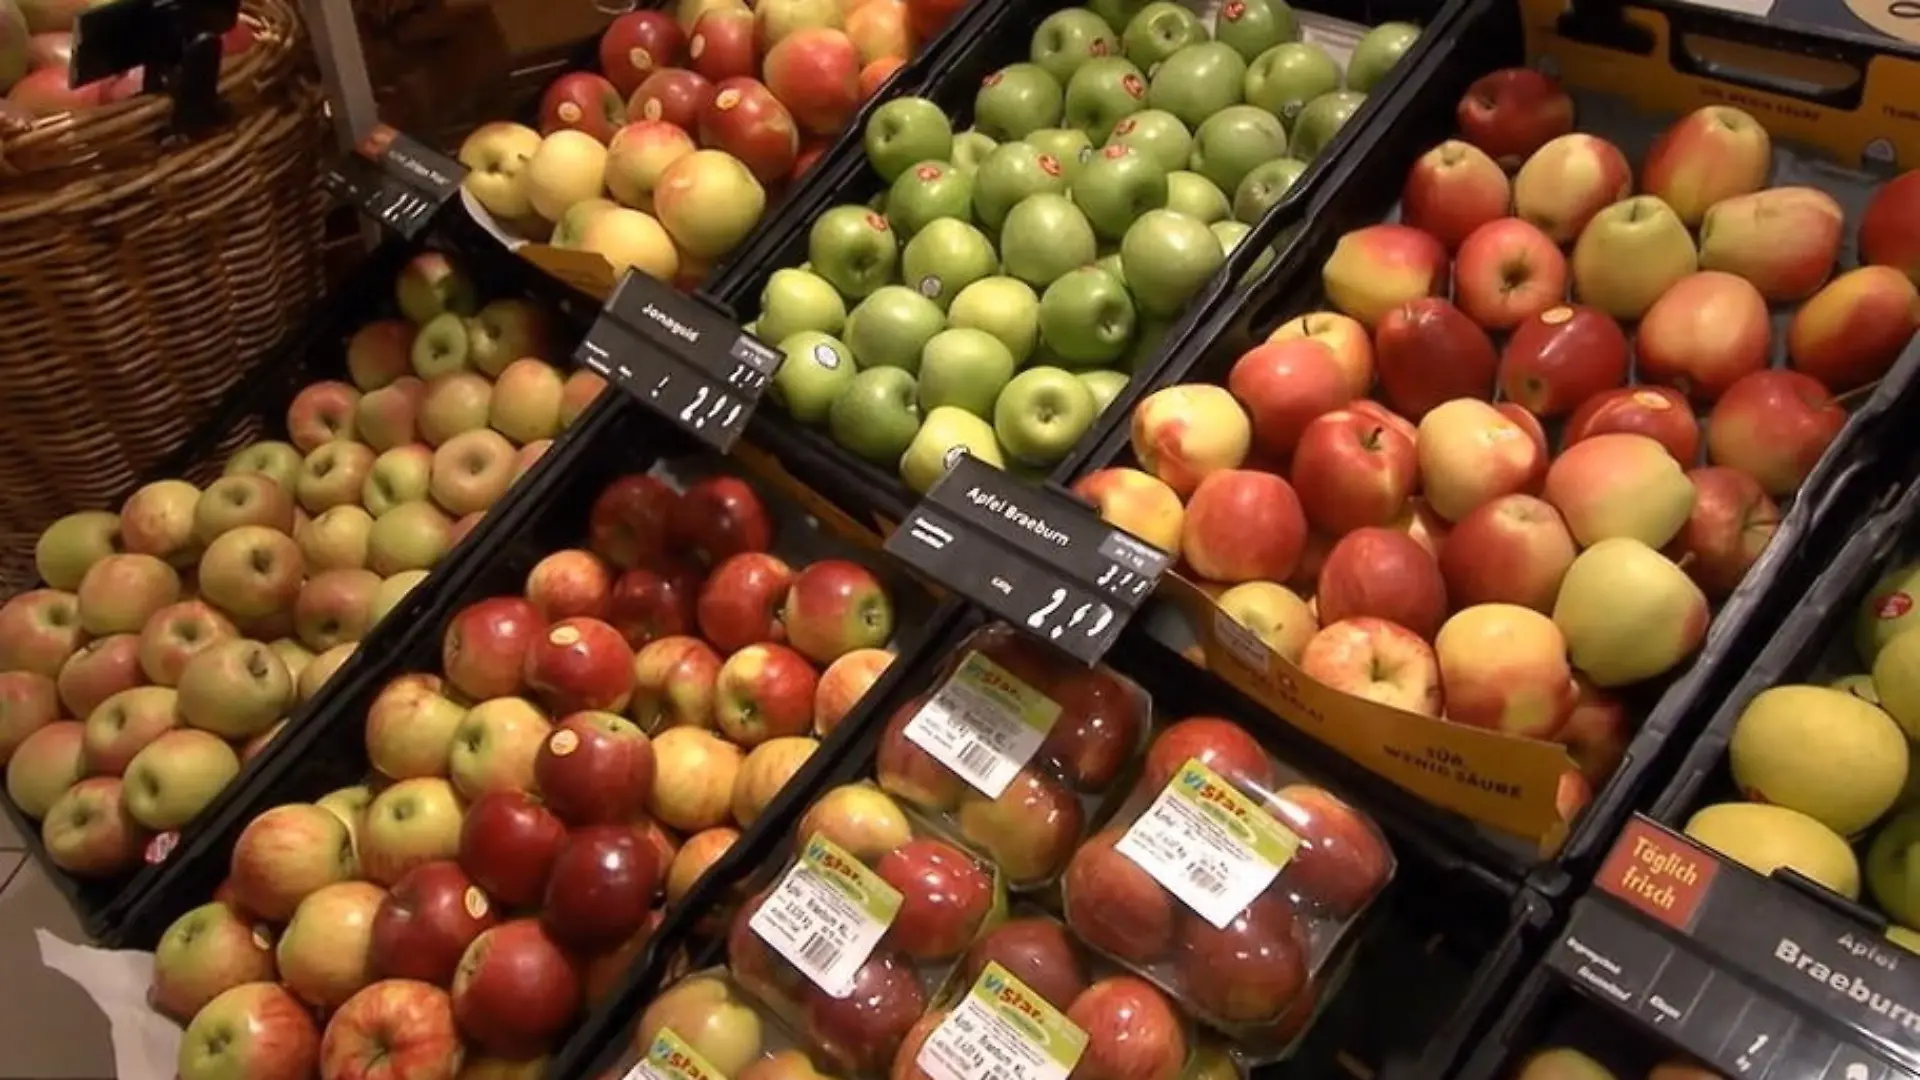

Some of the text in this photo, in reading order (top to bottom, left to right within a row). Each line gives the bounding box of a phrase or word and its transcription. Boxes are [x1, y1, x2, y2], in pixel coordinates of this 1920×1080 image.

[966, 487, 1071, 548] Apfel Braeburn
[1631, 835, 1698, 887] Täglich
[1621, 866, 1678, 910] frisch
